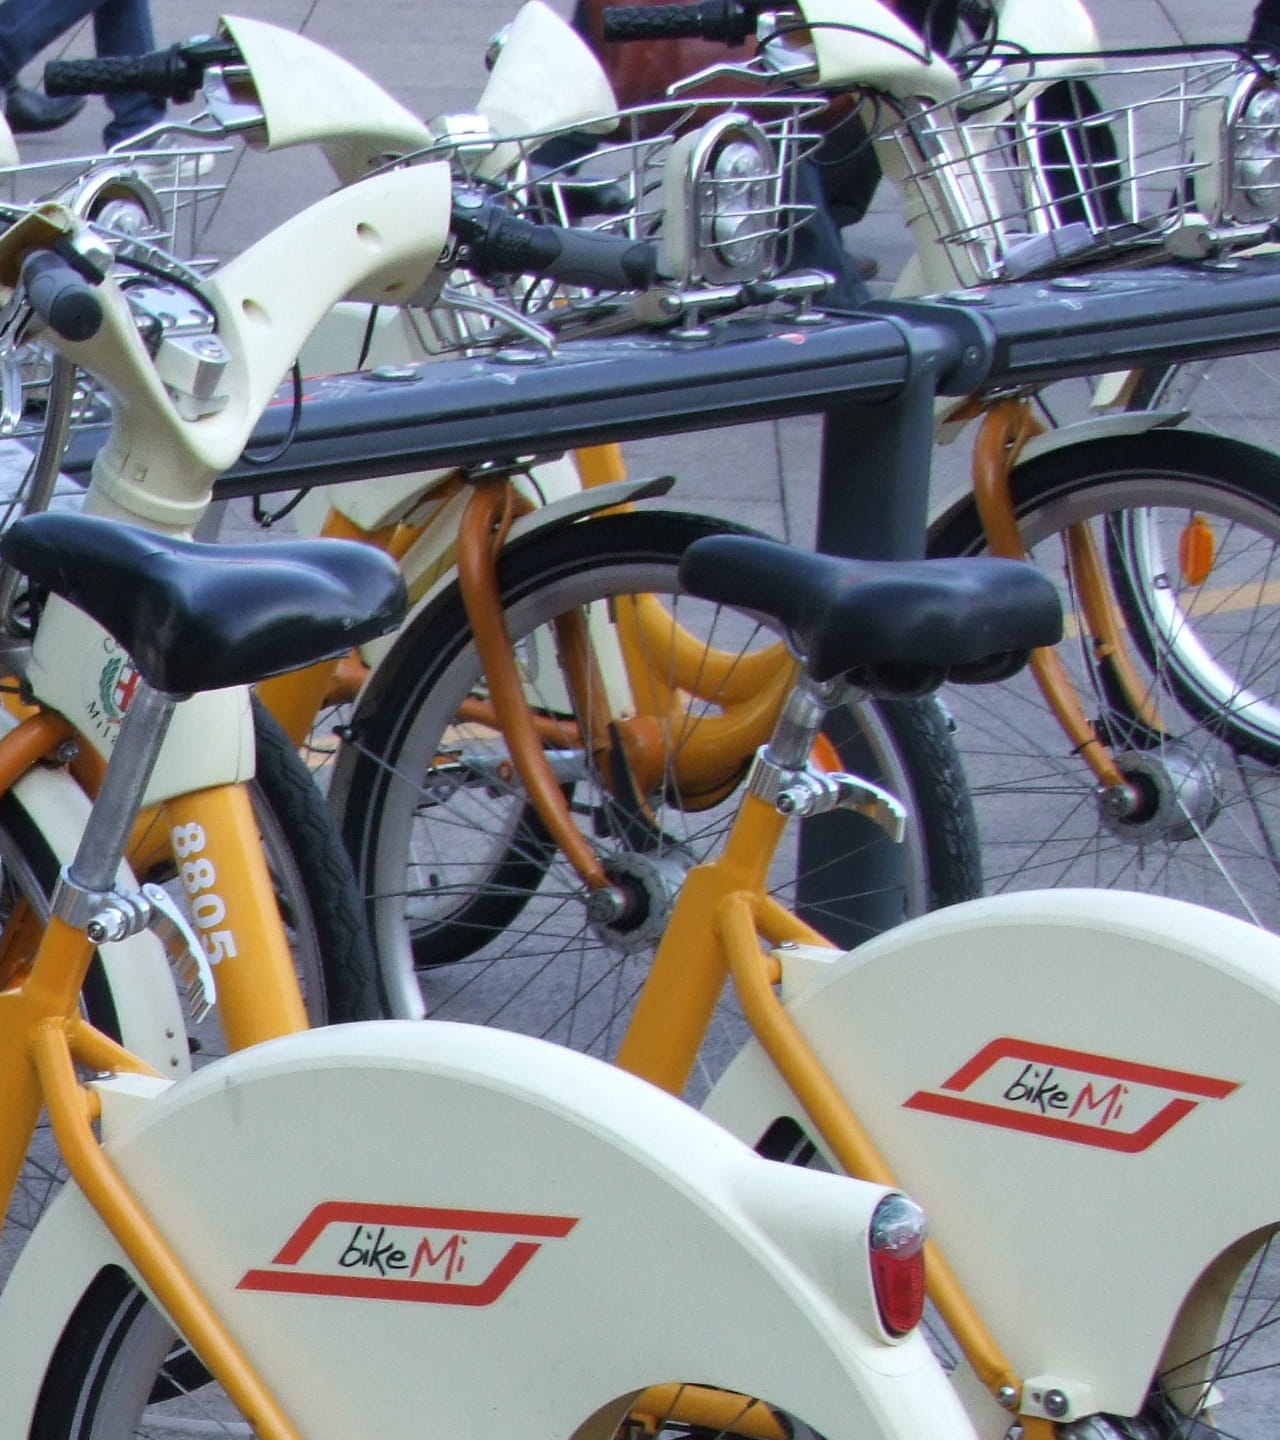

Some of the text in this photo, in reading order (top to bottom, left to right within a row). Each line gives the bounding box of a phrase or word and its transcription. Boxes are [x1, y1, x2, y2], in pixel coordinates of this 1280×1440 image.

[172, 821, 238, 966] 8805
[1003, 1063, 1129, 1126] bikeMi
[338, 1224, 468, 1281] bikeMi
